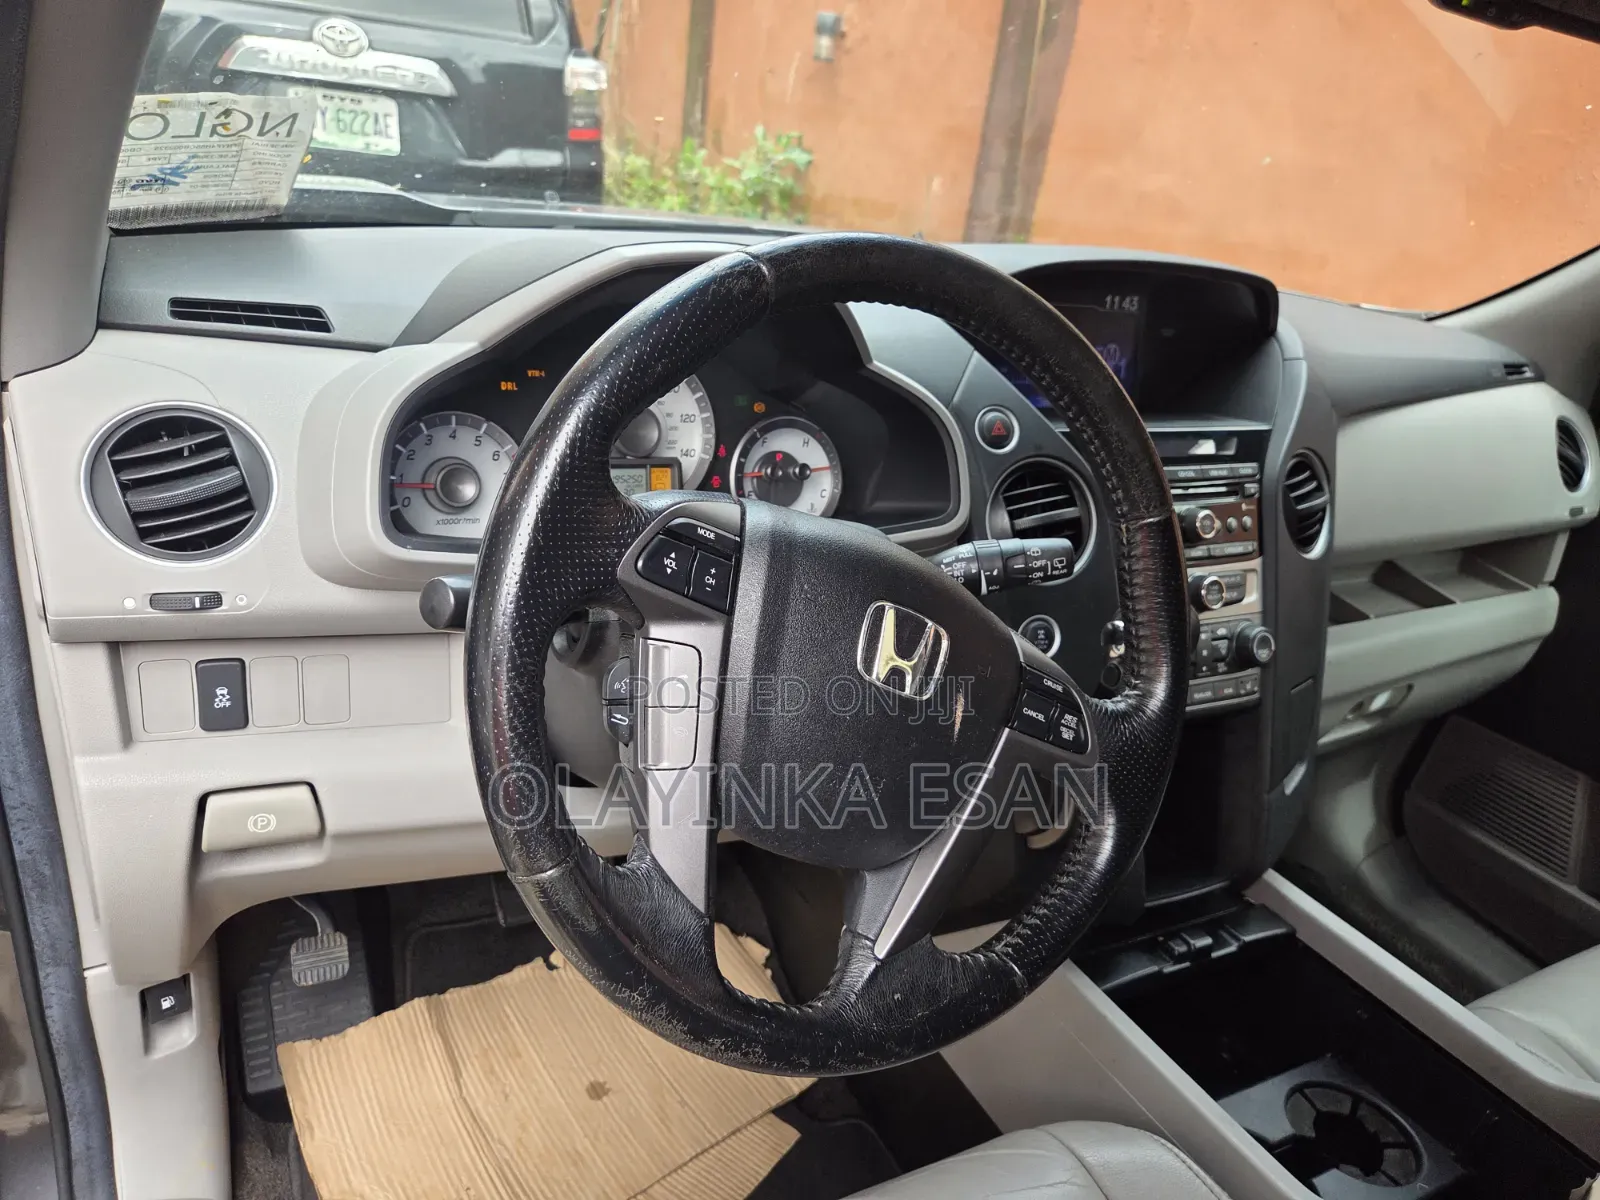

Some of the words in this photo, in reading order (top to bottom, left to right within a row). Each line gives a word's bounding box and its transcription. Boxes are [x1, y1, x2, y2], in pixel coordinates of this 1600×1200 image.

[500, 380, 518, 391] DRL
[680, 413, 696, 424] 120
[424, 434, 433, 446] 3
[449, 429, 457, 440] 4
[474, 435, 482, 447] 5
[761, 437, 768, 447] F
[802, 438, 810, 448] H
[406, 449, 415, 460] 2
[492, 450, 500, 461] 6
[680, 448, 696, 458] 140
[820, 489, 827, 498] C
[401, 496, 411, 508] 0
[697, 527, 716, 540] MODE
[663, 557, 678, 570] VOL
[952, 562, 966, 570] OFF
[1032, 560, 1047, 568] OFF
[953, 569, 965, 577] INT
[705, 575, 716, 586] CH
[1043, 678, 1063, 693] CRUISE
[214, 701, 231, 709] OFF
[1022, 707, 1046, 723] CANCEL
